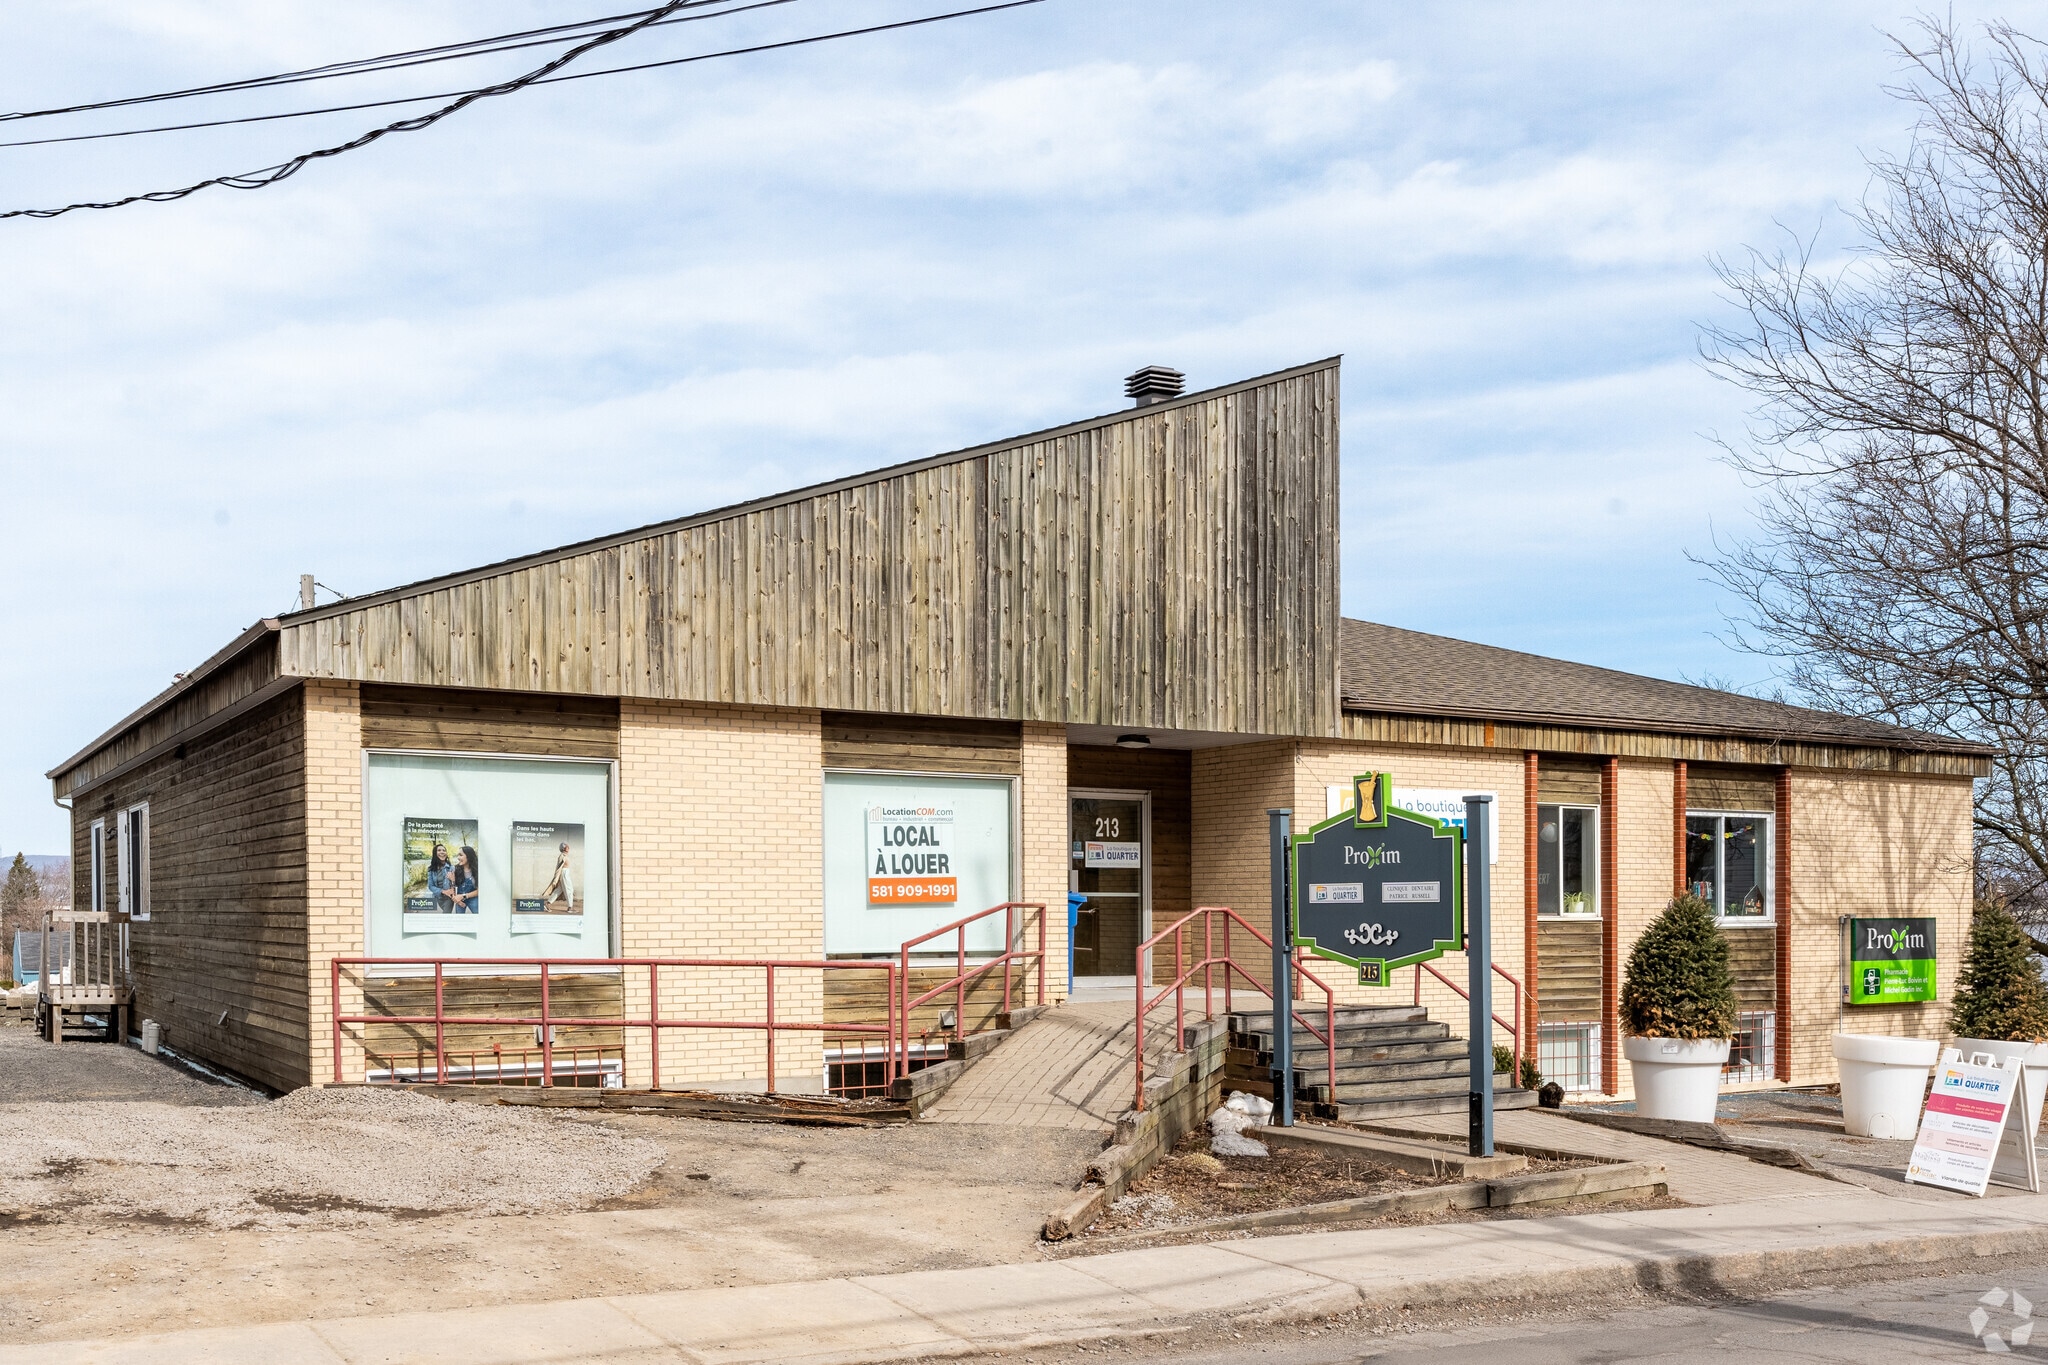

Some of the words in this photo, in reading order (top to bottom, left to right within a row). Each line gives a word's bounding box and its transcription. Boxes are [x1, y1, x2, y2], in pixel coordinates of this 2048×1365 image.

[882, 808, 953, 816] LocationCOM.com
[1416, 799, 1467, 815] boutique
[1095, 817, 1119, 838] 213
[883, 825, 940, 847] LOCAL
[875, 848, 887, 874] À
[891, 853, 949, 874] LOUER
[1107, 851, 1139, 860] QUARTIER
[1343, 842, 1401, 870] Proxim
[872, 885, 893, 897] 581
[897, 884, 955, 897] 909-1991
[1332, 891, 1358, 900] QUARTIER
[1867, 925, 1924, 954] Proxim
[1361, 965, 1378, 979] 215
[1884, 977, 1907, 985] Pierre-Luc
[1884, 986, 1900, 994] Michel
[1965, 1080, 2000, 1092] QUARTIER
[1964, 1179, 1981, 1187] qualité
